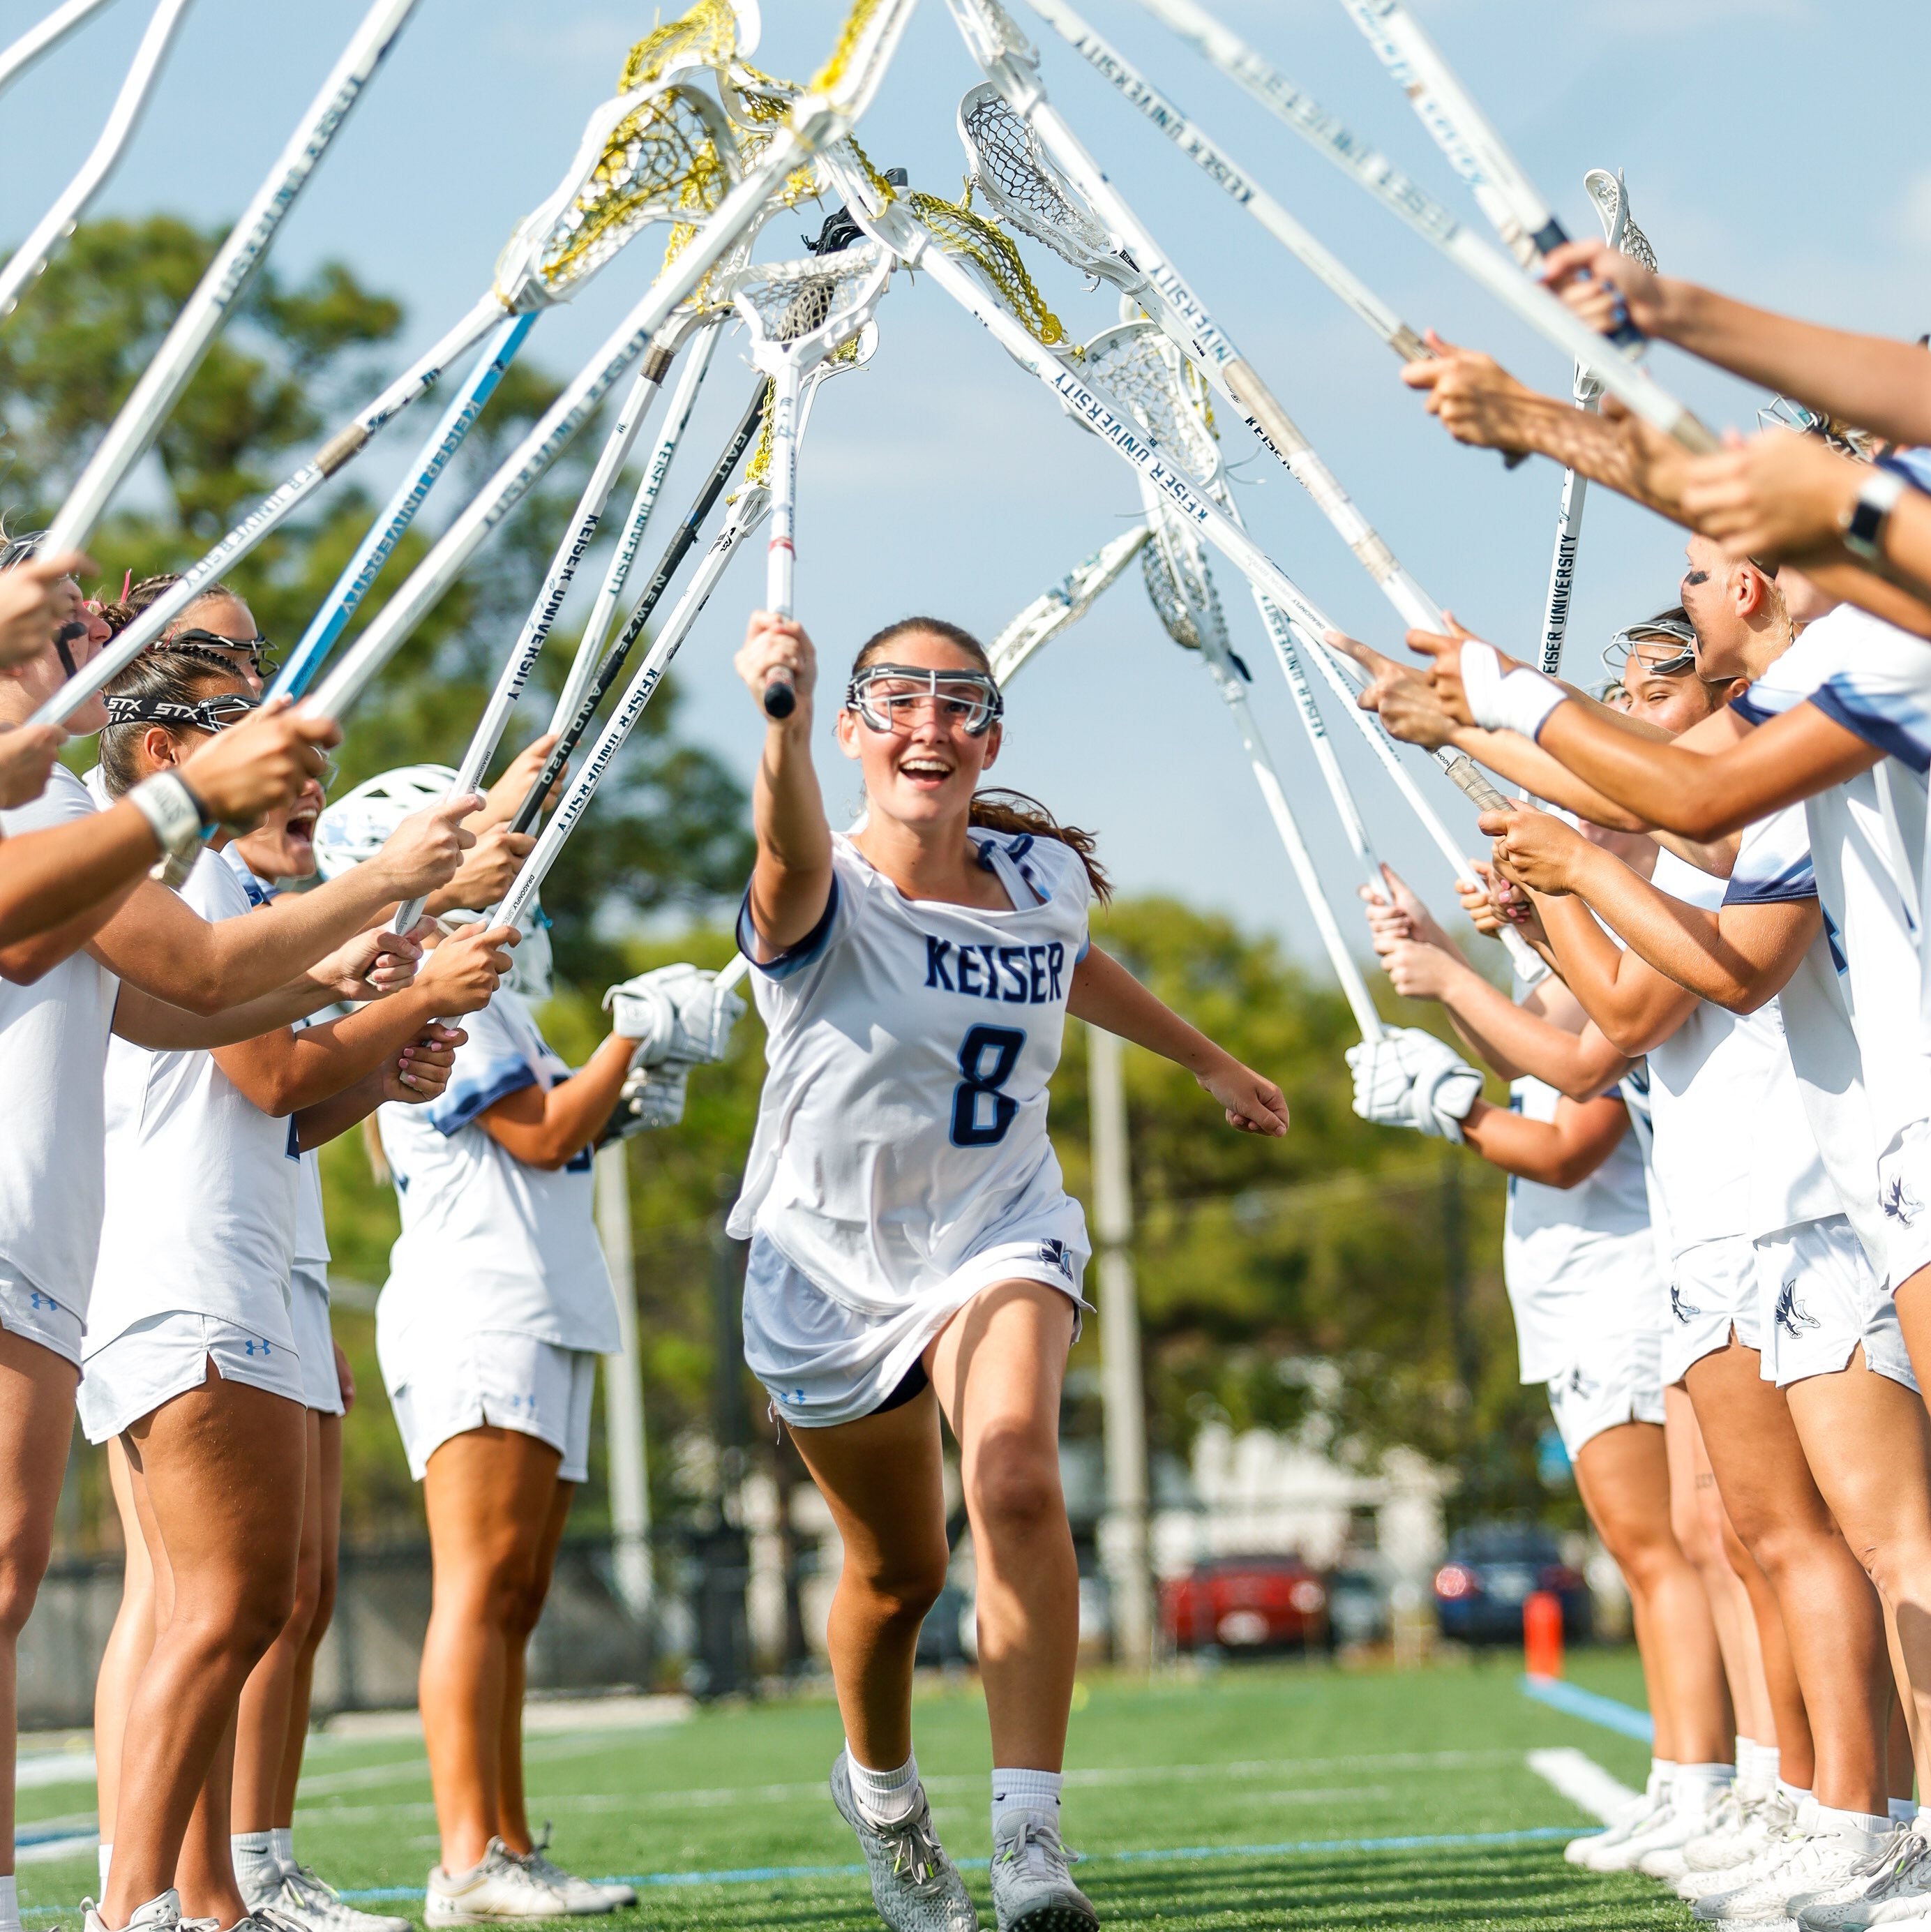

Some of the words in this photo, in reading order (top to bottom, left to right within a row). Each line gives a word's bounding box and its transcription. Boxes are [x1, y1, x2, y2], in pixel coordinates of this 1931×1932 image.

[1074, 36, 1185, 141] UNIVERSITY
[1187, 138, 1254, 204] KEISER
[1150, 262, 1234, 366] NIVERSITY
[426, 399, 481, 479] KEISER
[1053, 373, 1150, 466] UNIVERSITY
[646, 440, 675, 496] KEISER
[715, 431, 747, 481] GAIT
[1150, 461, 1208, 524] KEISER
[339, 480, 428, 616] UNIVERSITY
[560, 514, 601, 581] KEISER
[608, 502, 654, 598] UNIVERSITY
[1549, 533, 1577, 624] UNIVERSITY
[507, 589, 565, 701] UNIVERSITY
[1542, 631, 1563, 677] EISER
[107, 697, 142, 712] STX
[153, 703, 200, 720] STX
[619, 667, 659, 728] KEISER
[1298, 687, 1327, 738] KEISER
[472, 751, 492, 791] DRAGONFLY
[541, 740, 572, 785] U20
[558, 733, 622, 834] UNIVERSITY
[502, 910, 514, 927] SPEC
[513, 874, 535, 910] DRAGONFLY
[925, 934, 1065, 1005] KEISER
[949, 1022, 1028, 1148] 8
